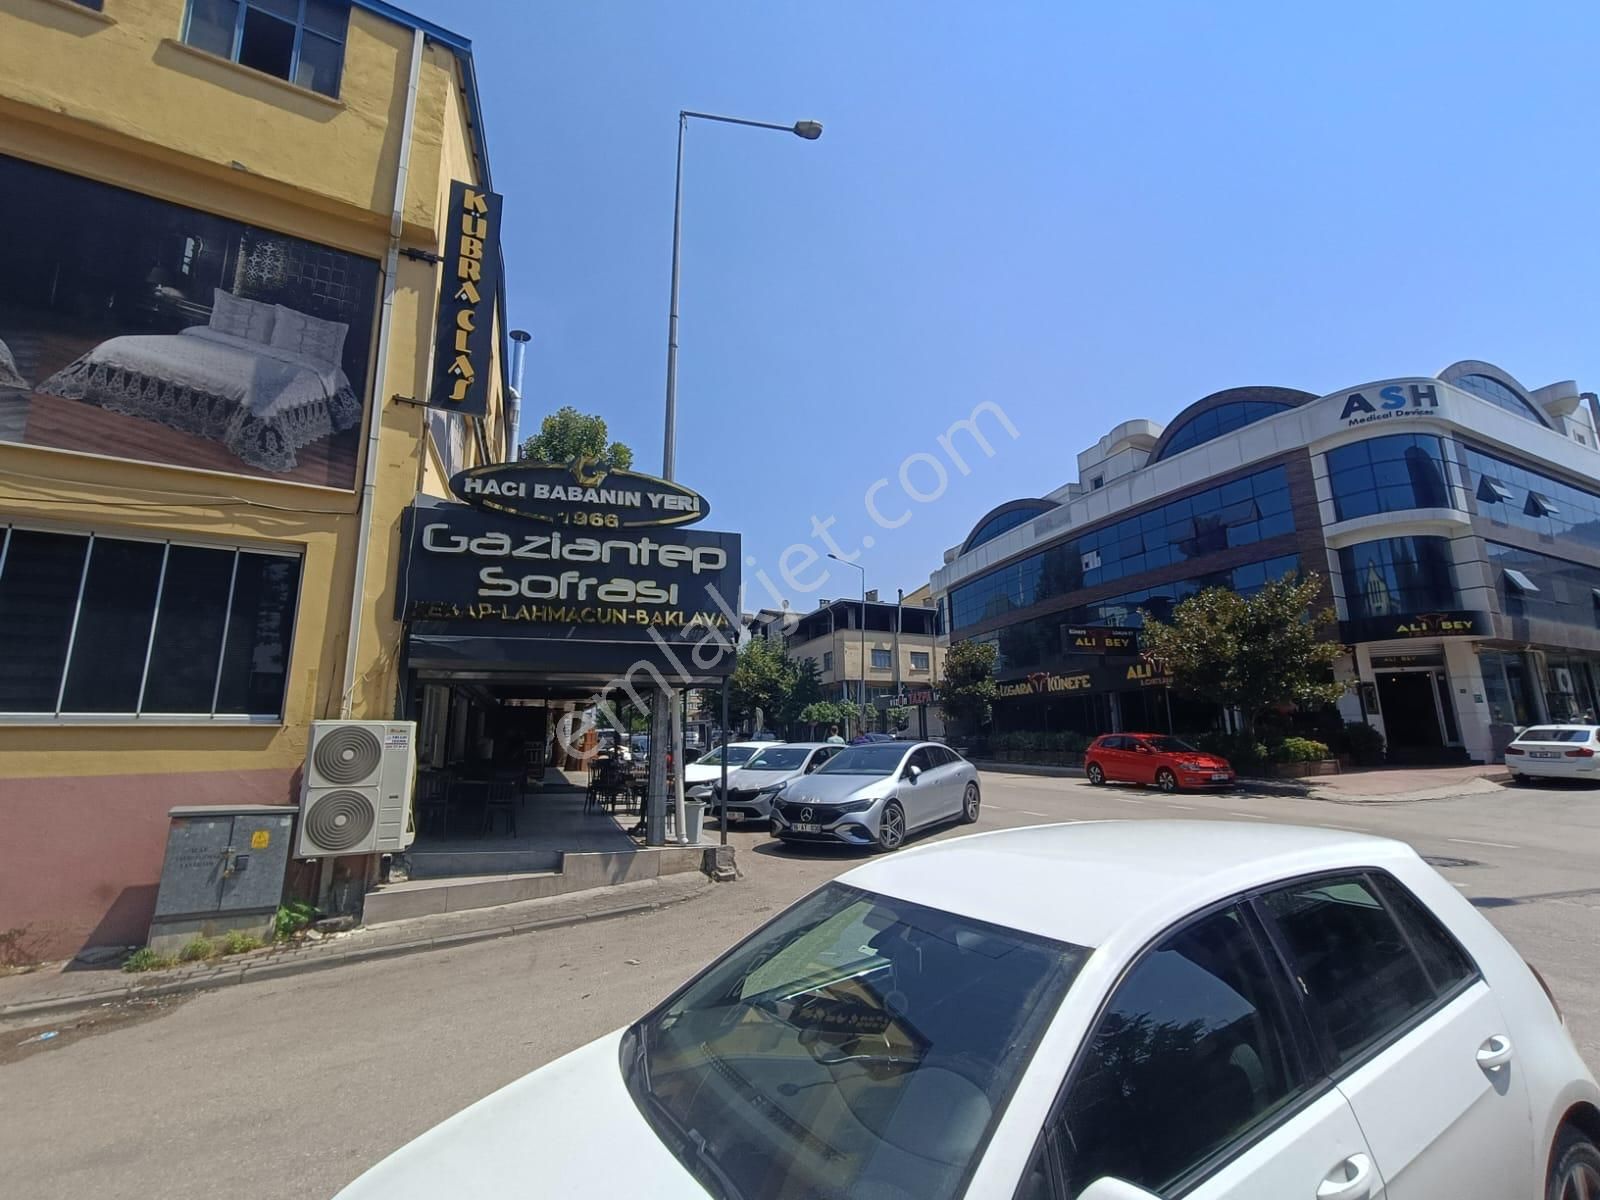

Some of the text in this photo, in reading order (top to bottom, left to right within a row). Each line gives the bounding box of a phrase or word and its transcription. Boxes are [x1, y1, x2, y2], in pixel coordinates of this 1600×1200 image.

[1341, 384, 1439, 419] ASH
[1348, 408, 1434, 427] Medical Devices
[464, 477, 526, 497] HACI
[533, 483, 641, 507] BABANIN
[557, 511, 620, 528] 1966
[422, 523, 727, 574] Gaziantep
[478, 566, 678, 605] Sofrası
[412, 600, 730, 629] EAP-LAHMACUN-BAKLAVA
[1396, 621, 1473, 633] ALI BEY
[1075, 637, 1130, 648] ALI BEY
